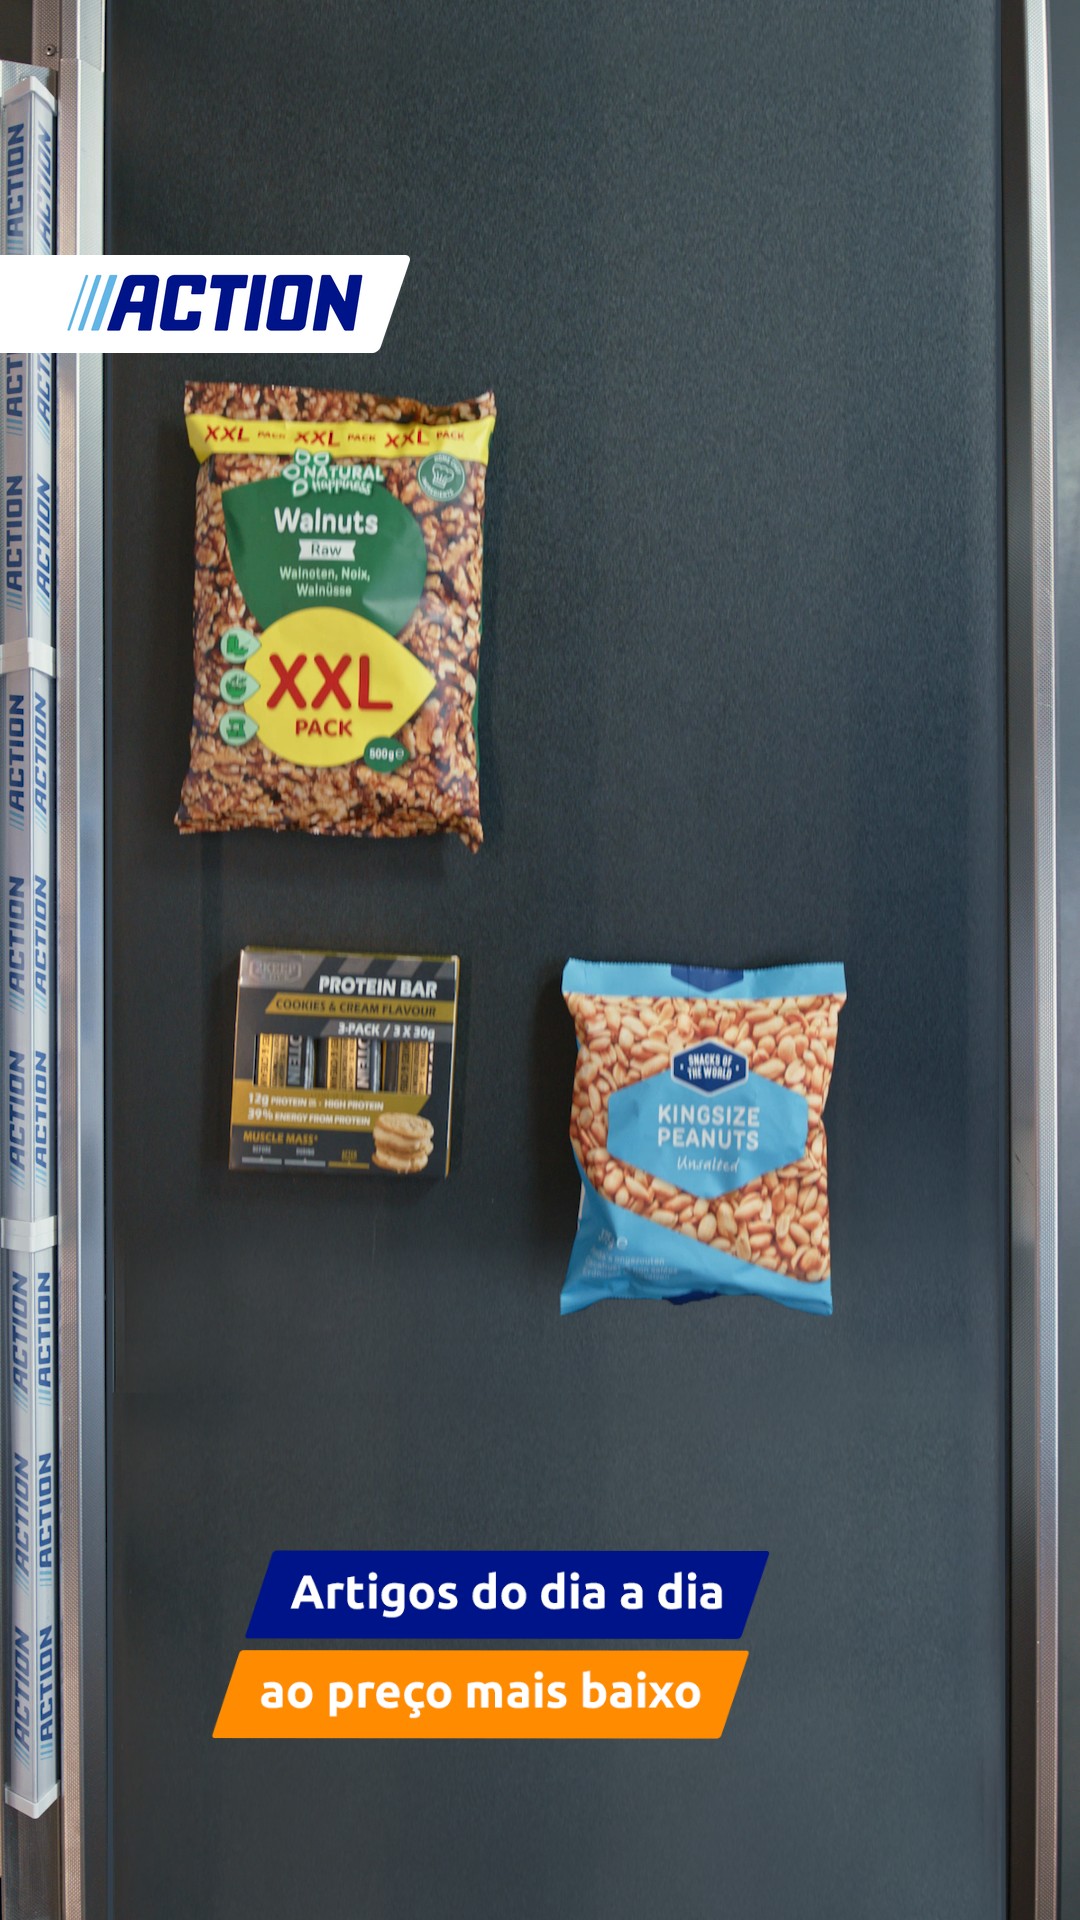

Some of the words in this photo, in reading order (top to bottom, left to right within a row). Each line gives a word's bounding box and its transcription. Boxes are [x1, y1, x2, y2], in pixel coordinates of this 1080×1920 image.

[7, 122, 24, 237] ACTION
[37, 120, 51, 254] ACTION
[6, 353, 23, 418] ACT
[205, 426, 250, 443] XXL
[294, 431, 340, 447] XXL
[385, 429, 430, 448] XXL
[436, 430, 465, 440] PACK
[304, 463, 384, 482] NATURAL
[6, 475, 23, 591] ACTION
[37, 473, 50, 598] ACTION
[274, 506, 378, 535] Walnuts
[312, 543, 342, 556] Raw
[297, 582, 352, 597] Walnüsse
[341, 566, 370, 582] Noix,
[266, 653, 393, 710] XXL
[295, 719, 352, 737] PACK
[9, 694, 24, 812] ACTION
[35, 692, 47, 814] ACTION
[9, 876, 25, 995] ACTION
[35, 875, 47, 995] ACTION
[276, 998, 325, 1012] COOKIES
[328, 1002, 336, 1012] &
[340, 1002, 379, 1015] CREAM
[382, 1003, 437, 1017] FLAVOUR
[318, 975, 397, 997] PROTEIN
[400, 979, 438, 998] BAR
[338, 1021, 380, 1036] 3-PACK
[393, 1025, 400, 1038] 3
[413, 1025, 435, 1042] 30g
[687, 1066, 702, 1080] THE
[703, 1066, 732, 1080] WORLD
[688, 1054, 720, 1067] SNACKS
[722, 1055, 733, 1066] OF
[9, 1050, 25, 1171] ACTION
[35, 1051, 47, 1169] ACTION
[248, 1092, 269, 1107] 12g
[271, 1096, 307, 1107] PROTEIN
[324, 1098, 346, 1109] HIGH
[347, 1100, 384, 1112] PROTEIN
[274, 1111, 308, 1123] ENERGY
[309, 1113, 334, 1124] FROM
[334, 1114, 371, 1127] PROTEIN
[658, 1104, 760, 1128] KINGSIZE
[243, 1130, 284, 1144] MUSCLE
[658, 1127, 759, 1152] PEANUTS
[677, 1155, 740, 1173] Unsalted
[12, 1271, 28, 1395] ACTION
[37, 1272, 50, 1388] ACTION
[14, 1452, 29, 1577] ACTION
[38, 1452, 51, 1568] ACTION
[15, 1626, 29, 1752] ACTION
[39, 1625, 53, 1742] ACTION
